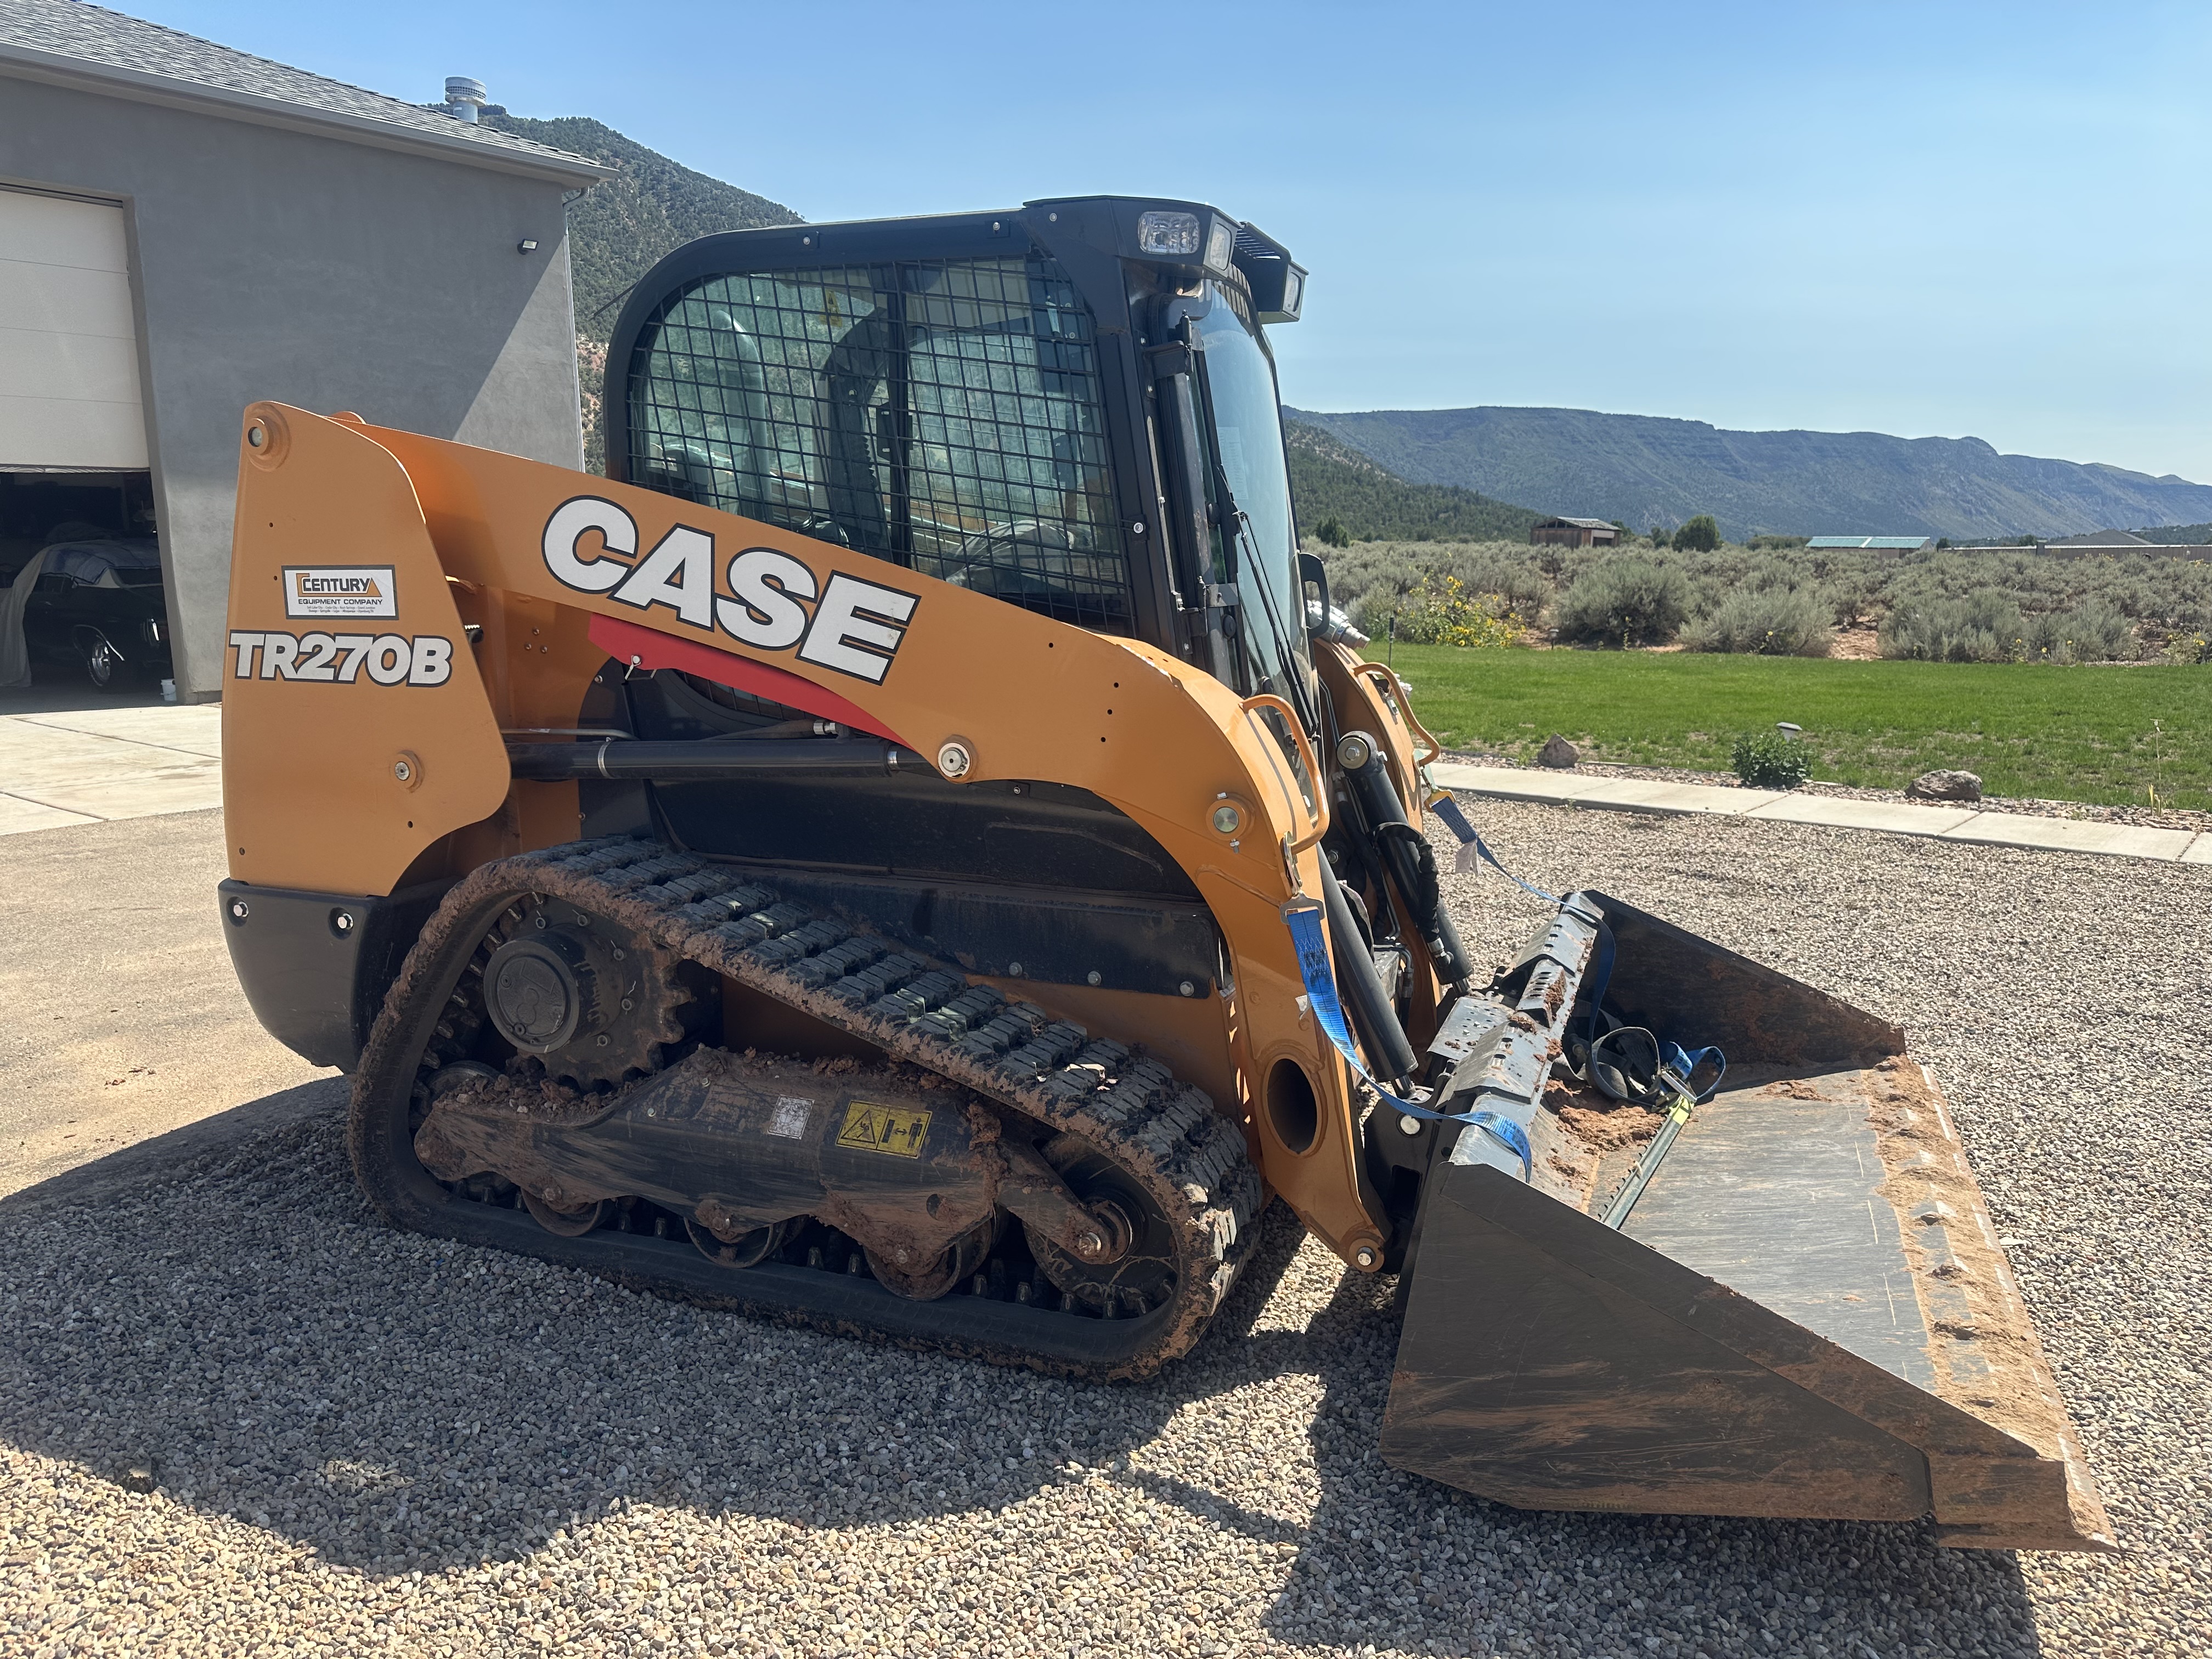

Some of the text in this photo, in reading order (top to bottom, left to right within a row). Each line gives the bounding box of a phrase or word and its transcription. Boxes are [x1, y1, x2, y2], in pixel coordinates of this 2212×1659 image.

[302, 578, 370, 592] CENTURY
[541, 495, 922, 686] CASE
[229, 629, 453, 687] TR270B
